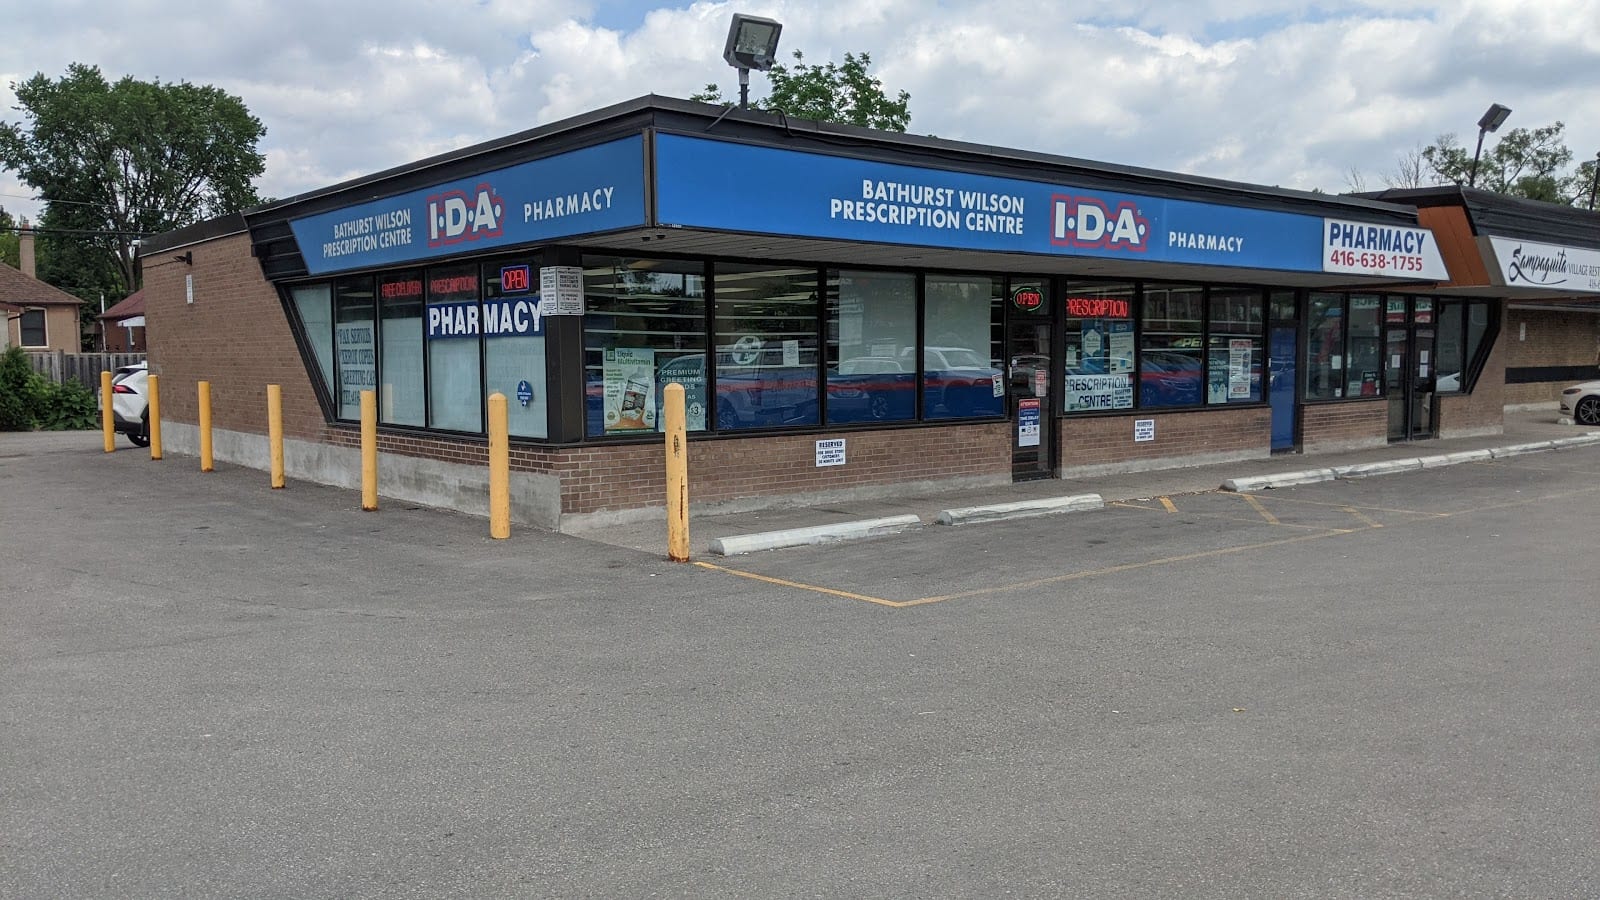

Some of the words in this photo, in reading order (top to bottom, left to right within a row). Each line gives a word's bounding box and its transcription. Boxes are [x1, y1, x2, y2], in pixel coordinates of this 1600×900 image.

[524, 187, 615, 223] PHARMACY
[863, 179, 954, 208] BATHURST
[959, 190, 1025, 215] WILSON
[334, 215, 373, 239] BATHURST
[374, 208, 411, 230] WILSON
[830, 199, 960, 230] PRESCRIPTION
[965, 212, 1024, 235] CENTRE
[323, 231, 378, 258] PRESCRIPTION
[379, 227, 412, 250] CENTRE
[1169, 231, 1244, 252] PHARMACY
[1329, 222, 1426, 255] PHARMACY
[1330, 249, 1423, 272] 416-638-1755
[1568, 263, 1588, 276] VILLAGE
[503, 268, 527, 290] OPEN
[1016, 292, 1040, 306] OPEN
[429, 300, 543, 336] PHARMACY
[1078, 394, 1112, 407] CENTRE
[818, 440, 843, 448] RESERVED
